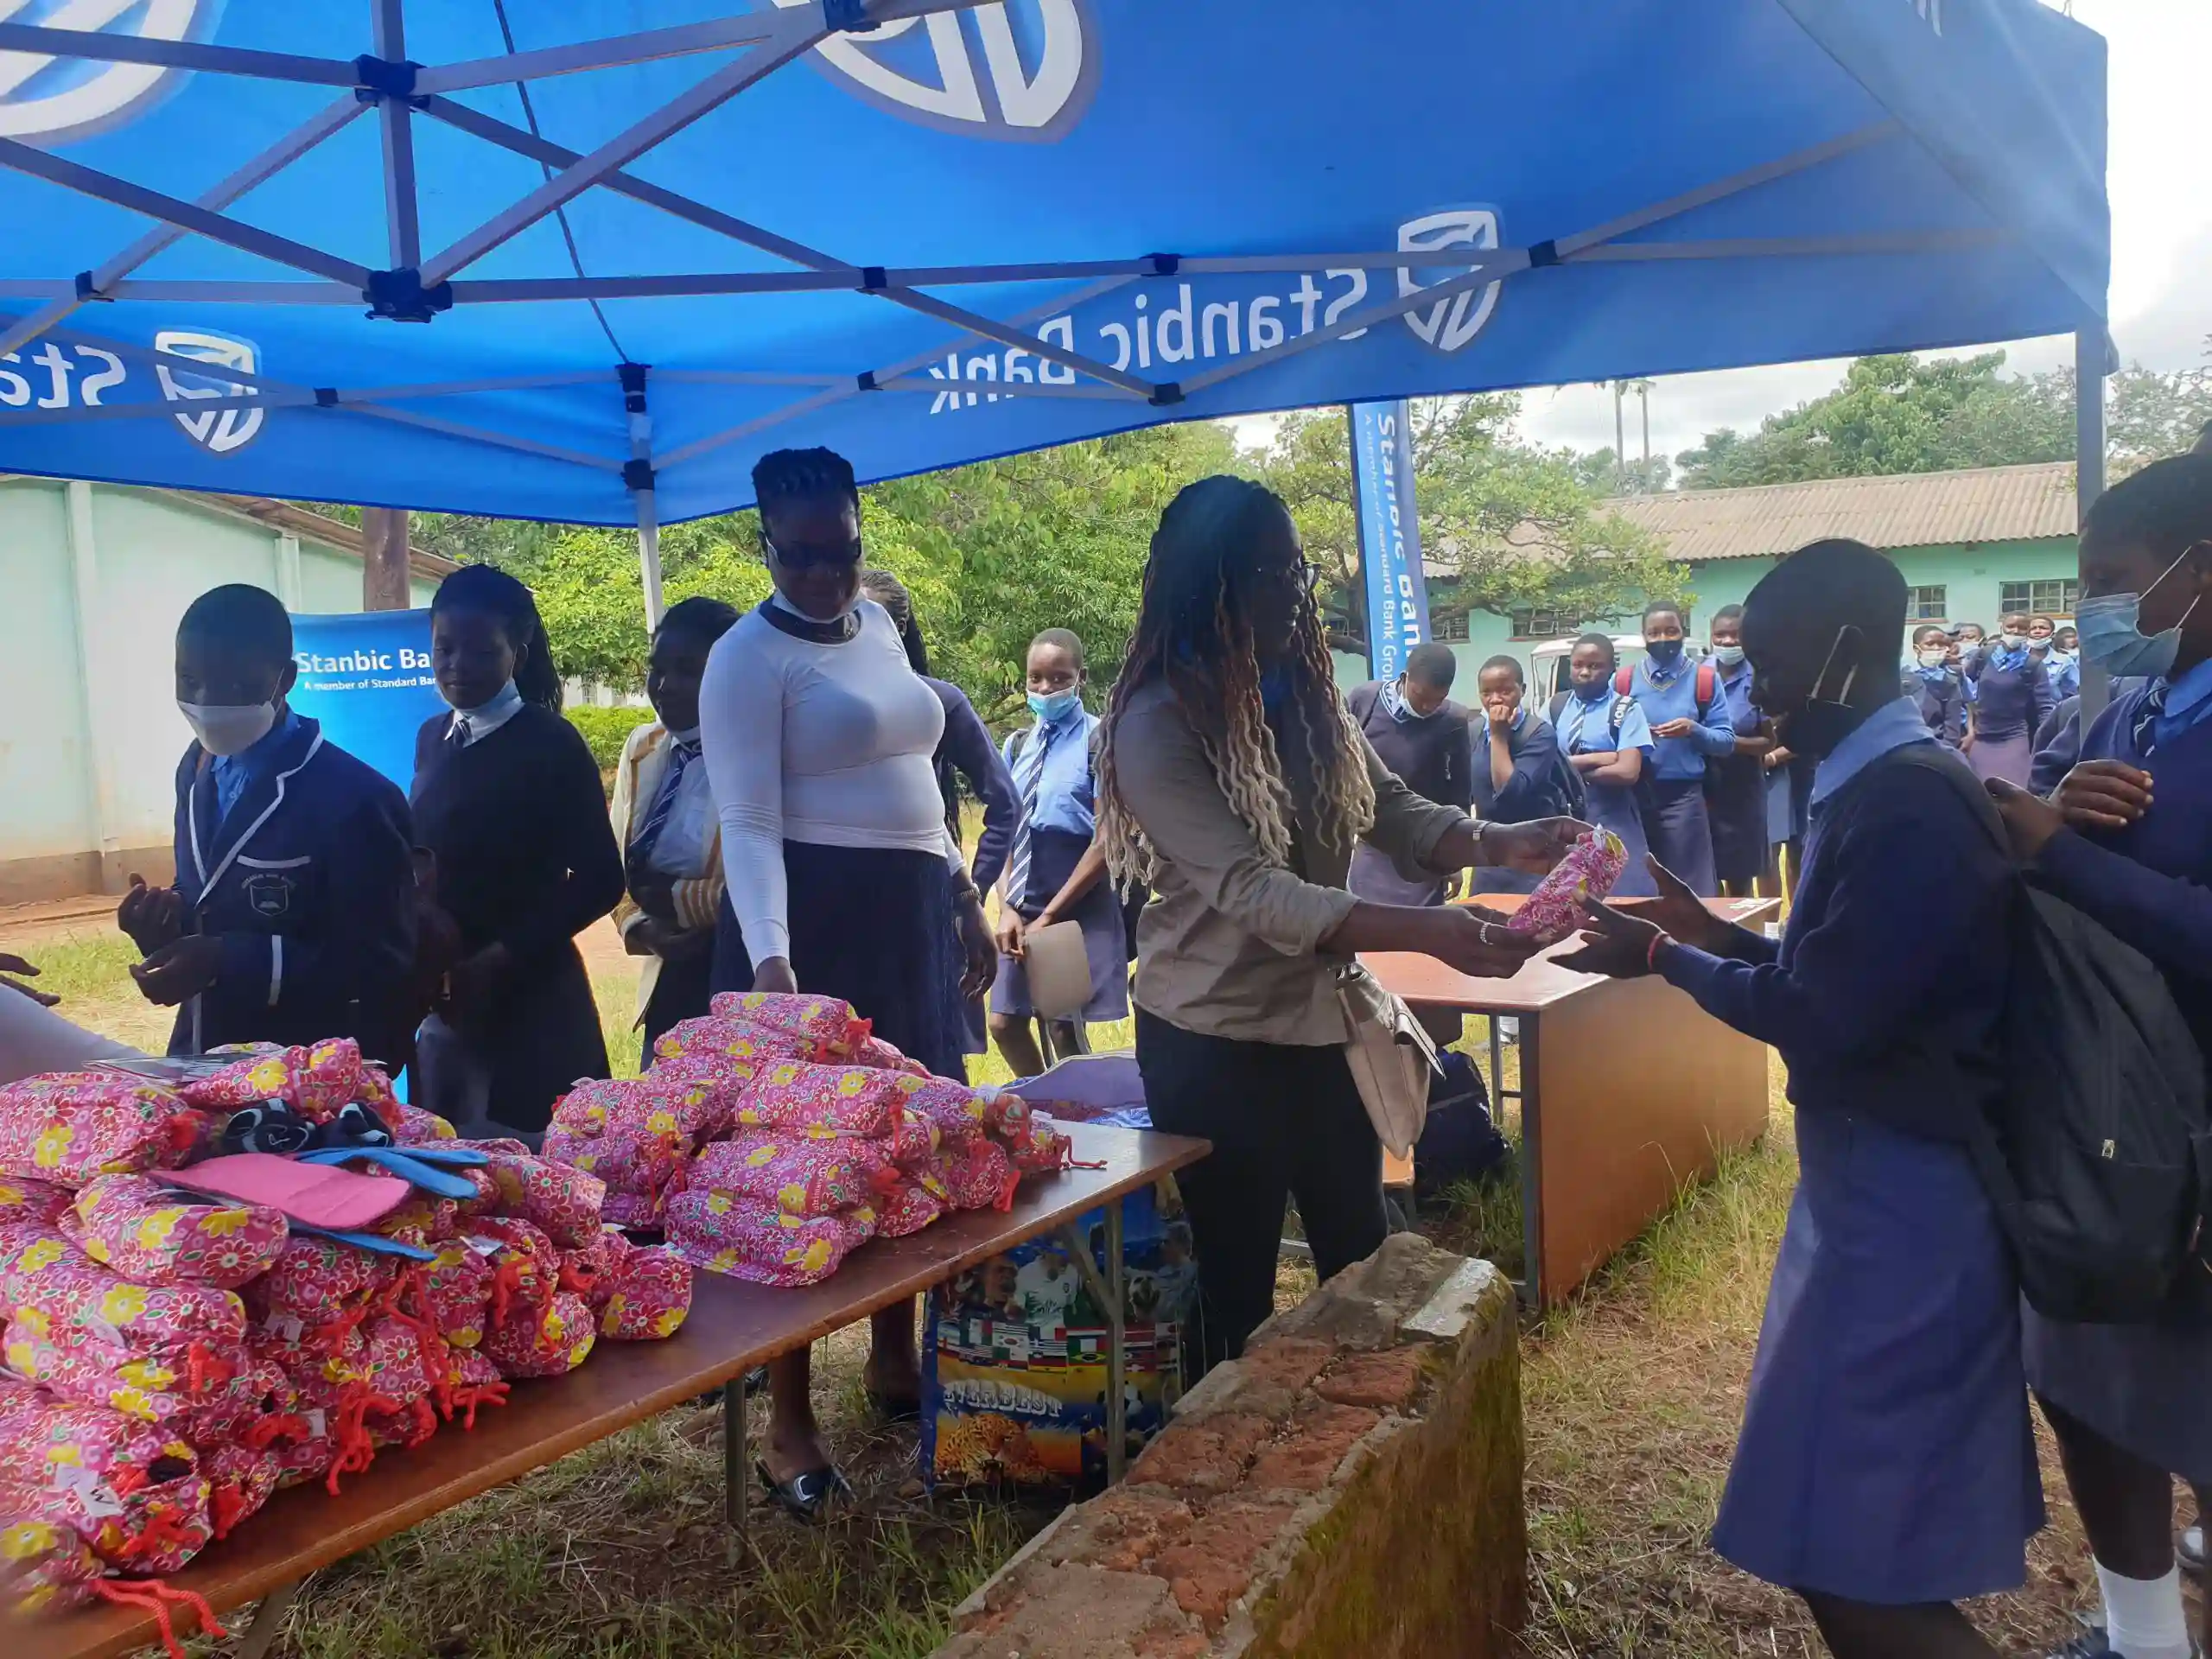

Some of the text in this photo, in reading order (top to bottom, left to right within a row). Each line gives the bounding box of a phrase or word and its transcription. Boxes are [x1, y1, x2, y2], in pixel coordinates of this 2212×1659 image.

[1382, 600, 1396, 640] Bank
[296, 649, 393, 674] Stanbic
[304, 681, 312, 691] A
[313, 679, 355, 691] member
[358, 678, 369, 690] of
[372, 677, 417, 689] Standard
